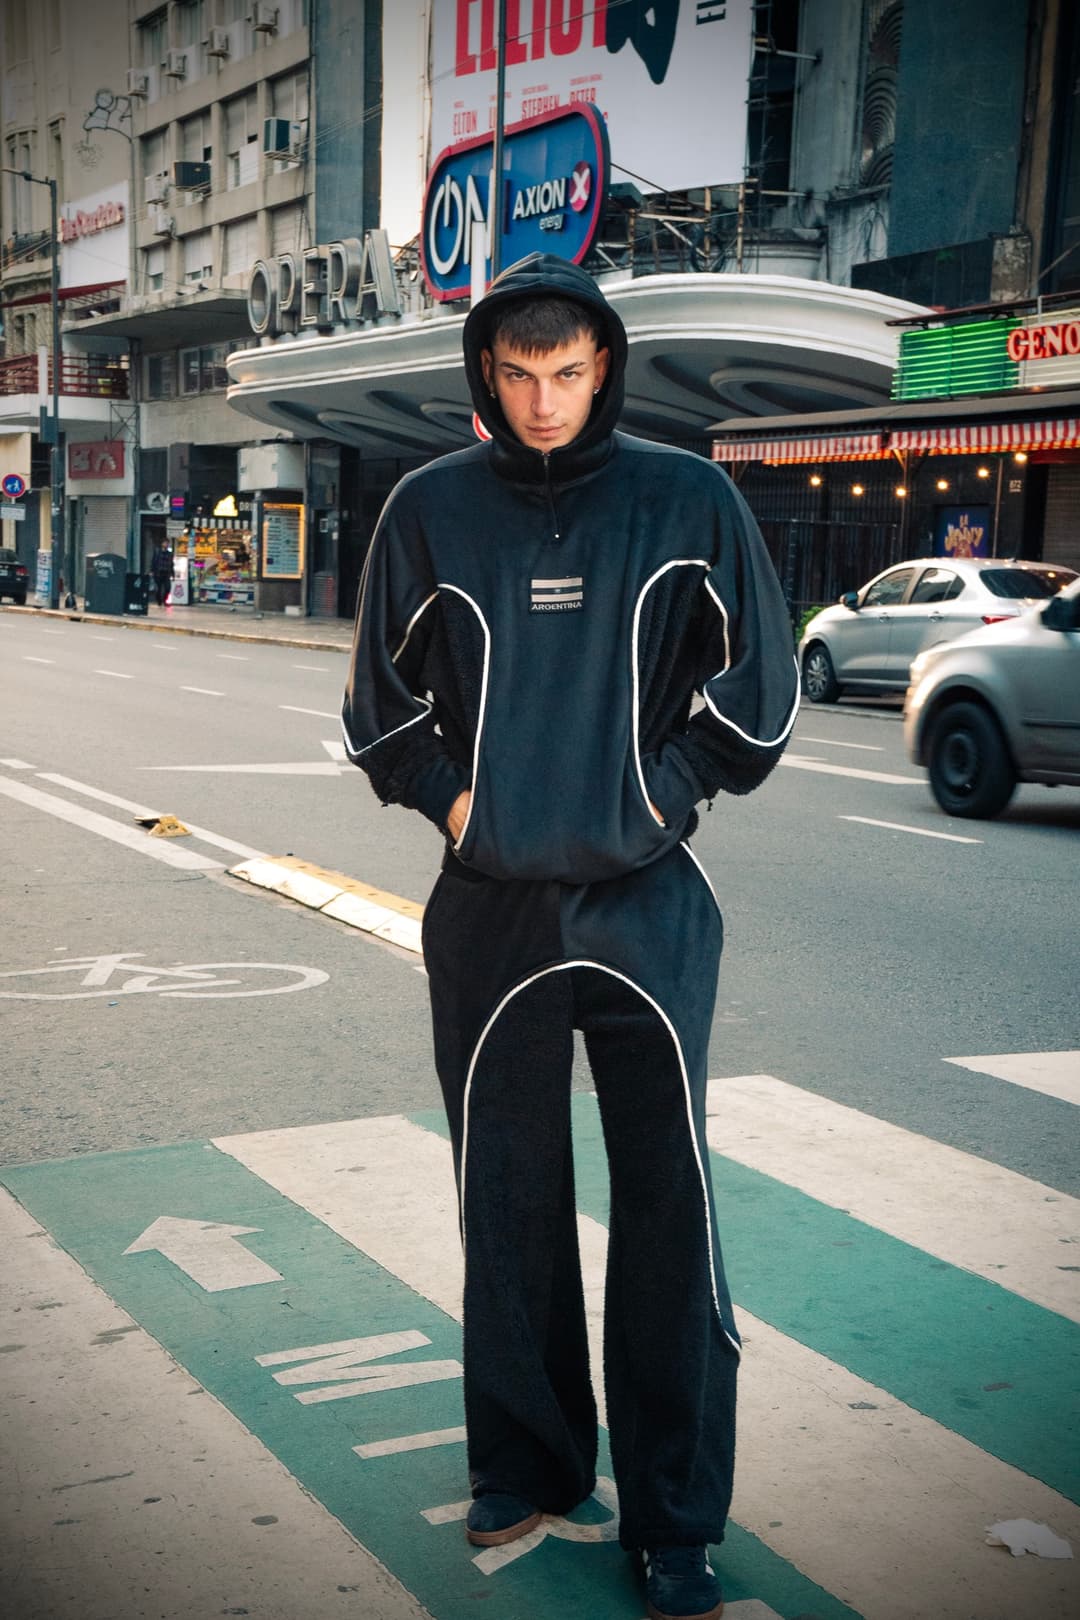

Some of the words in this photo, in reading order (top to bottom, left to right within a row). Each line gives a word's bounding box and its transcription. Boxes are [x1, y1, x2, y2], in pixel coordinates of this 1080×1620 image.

[453, 110, 478, 136] ELTON
[512, 178, 566, 220] AXION
[539, 213, 564, 230] energy
[247, 229, 402, 334] OPERA
[531, 601, 582, 610] ARGENTINA
